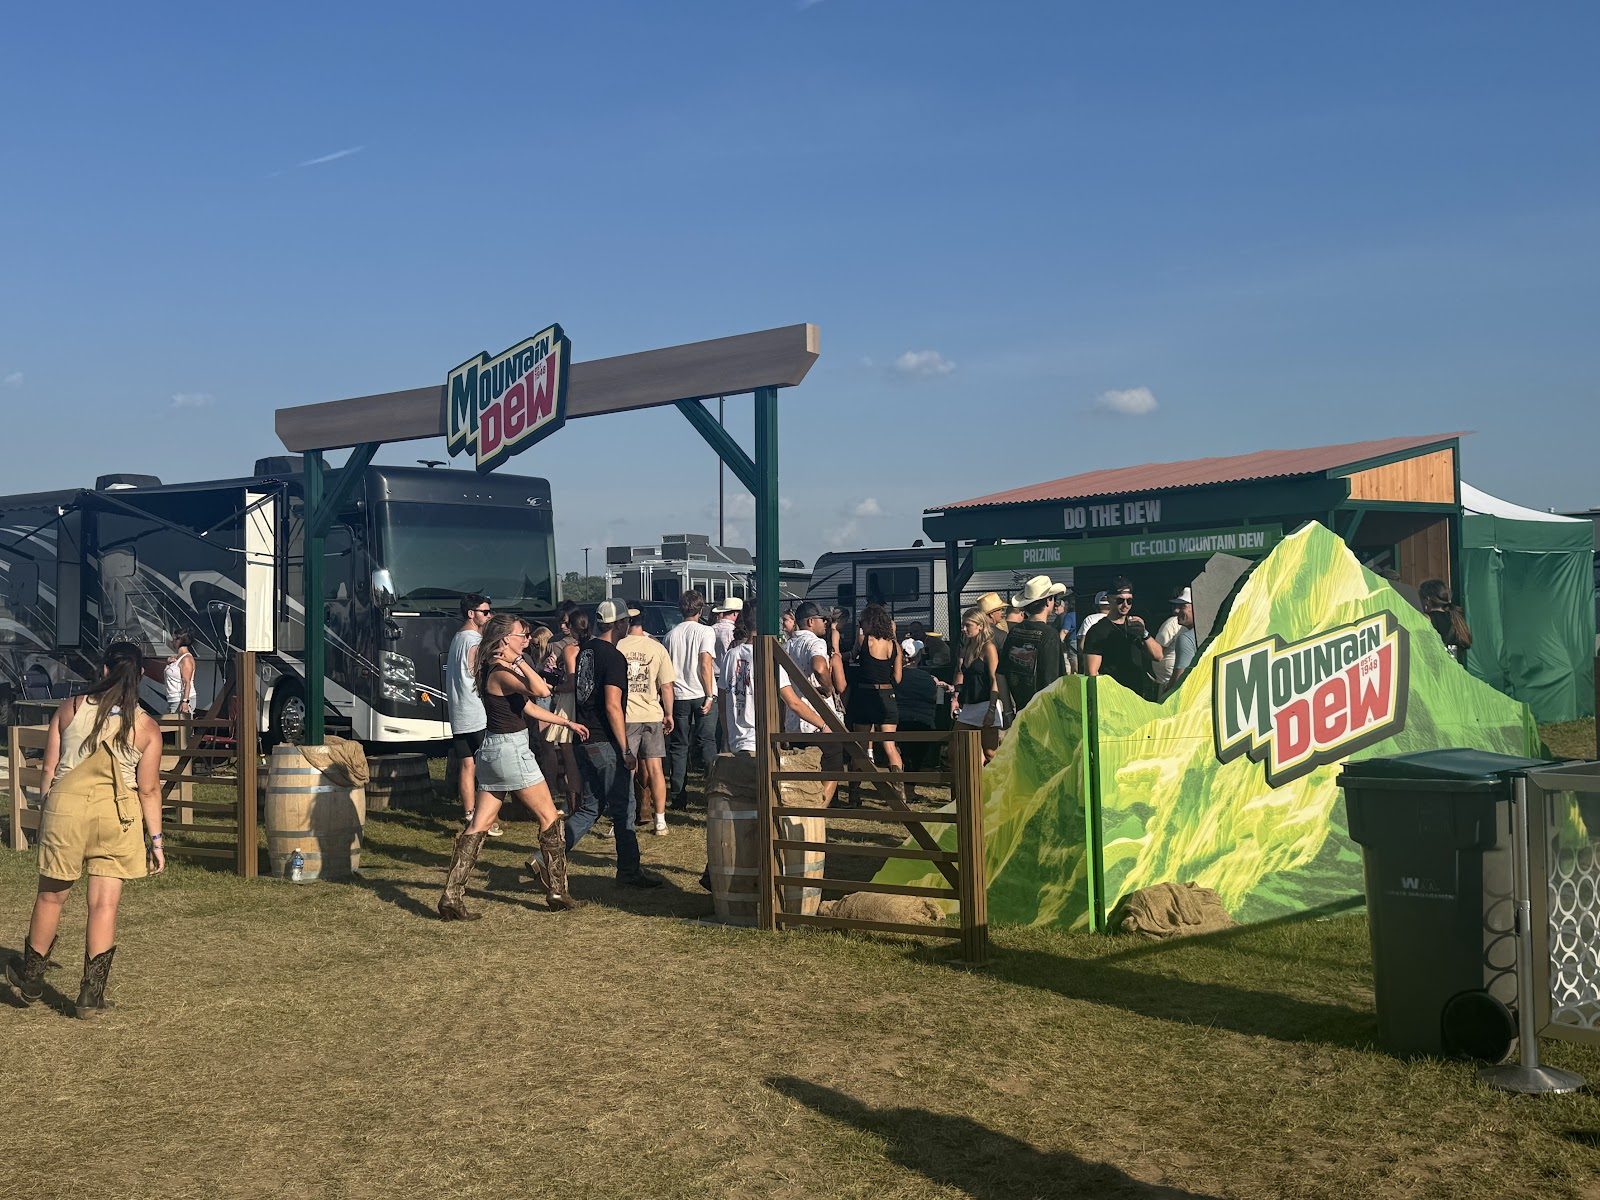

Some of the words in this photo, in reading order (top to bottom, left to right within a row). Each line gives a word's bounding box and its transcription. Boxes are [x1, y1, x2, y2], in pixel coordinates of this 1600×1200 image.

[1063, 506, 1087, 530] DO
[1089, 503, 1121, 528] THE
[1123, 499, 1161, 525] DEW
[1023, 546, 1061, 563] PRIZING
[1130, 539, 1176, 557] ICE-COLD
[1178, 534, 1236, 553] MOUNTAIN
[1238, 531, 1265, 549] DEW
[1360, 659, 1378, 677] 1948
